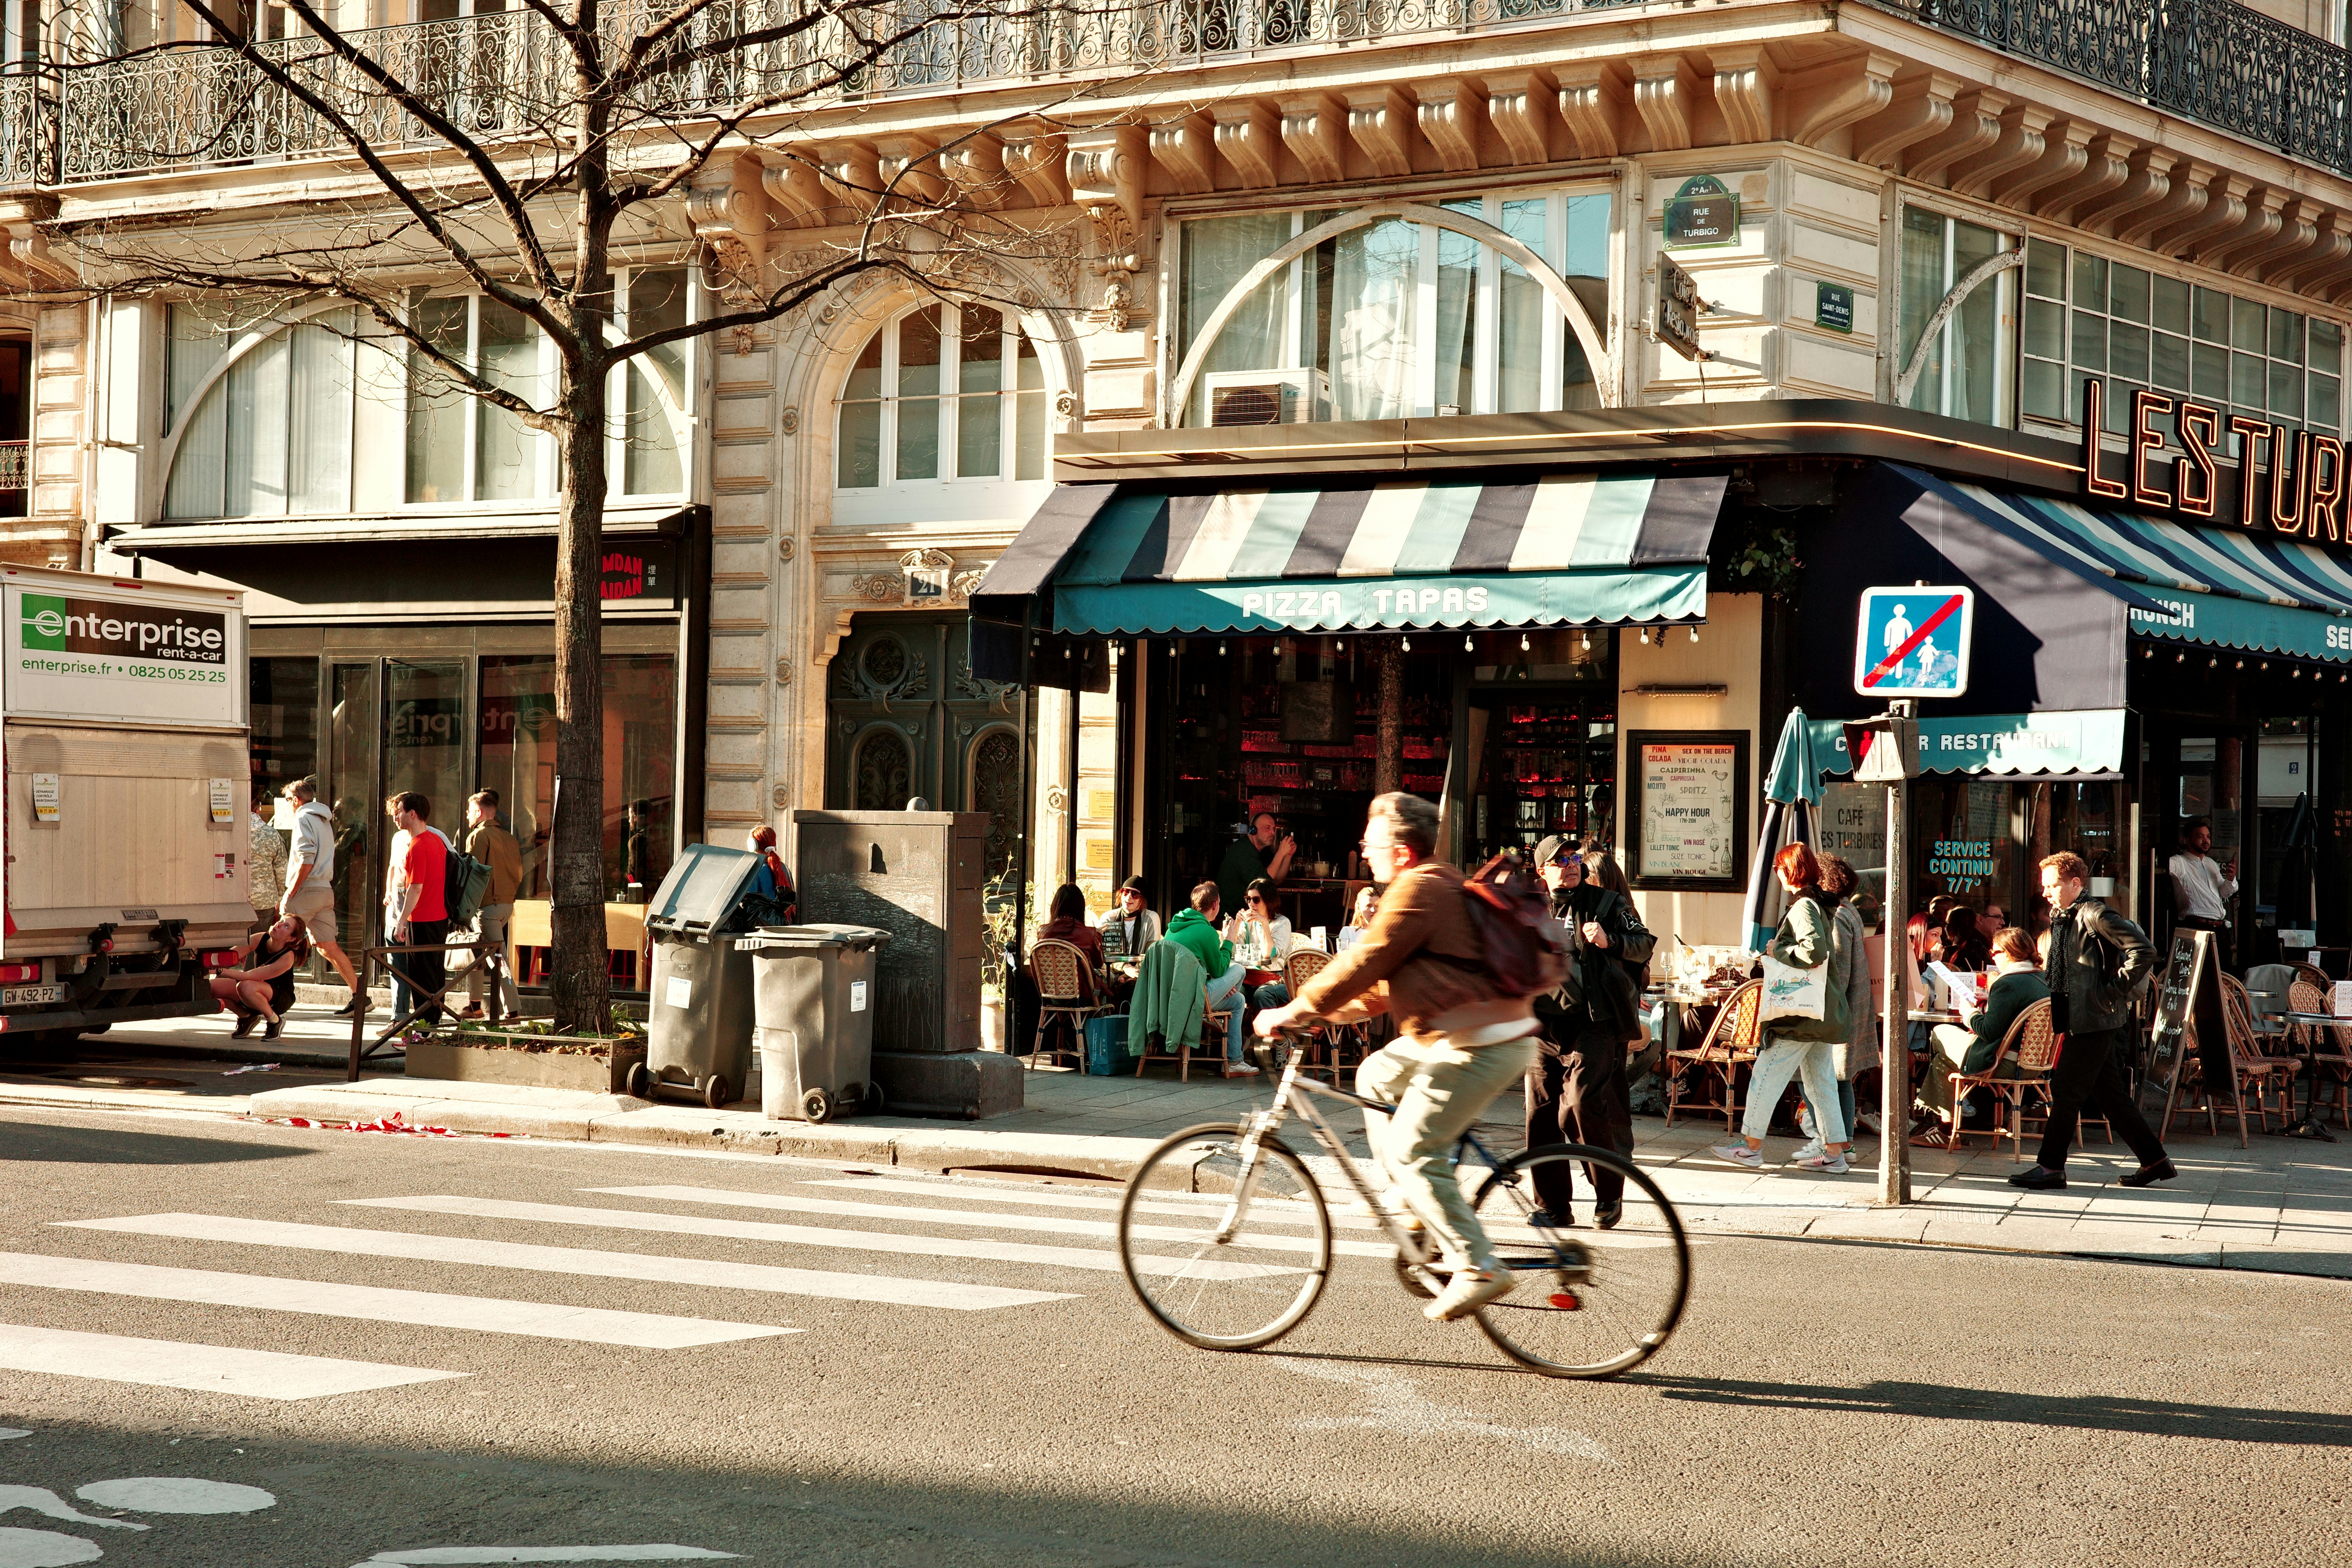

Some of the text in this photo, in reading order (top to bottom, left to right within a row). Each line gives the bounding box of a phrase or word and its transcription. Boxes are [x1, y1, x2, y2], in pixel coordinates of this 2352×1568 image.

[1683, 227, 1719, 237] TURBIGO
[1831, 293, 1840, 302] RUE
[1822, 302, 1849, 316] SAINT-DENIS
[602, 553, 642, 576] MDAN
[647, 564, 656, 586] 埋單
[917, 573, 936, 593] 21
[601, 576, 642, 600] AIDAN
[1242, 586, 1489, 617] PIZZA TAPAS
[22, 610, 222, 651] enterprise
[2327, 624, 2352, 651] SE
[157, 647, 221, 661] rent-a-car
[22, 659, 226, 683] enterprise.fr 0825 05 25 25
[1940, 731, 2071, 751] RESTAURANT
[2290, 763, 2297, 774] 2
[1666, 808, 1710, 817] HAPPY HOUR
[1838, 804, 1863, 827] CAFÉ
[1822, 830, 1885, 850] ES TURBINES
[1934, 841, 1991, 857] SERVICE
[1929, 858, 1994, 875] CONTINU
[5, 988, 54, 1004] GW-492-PZ
